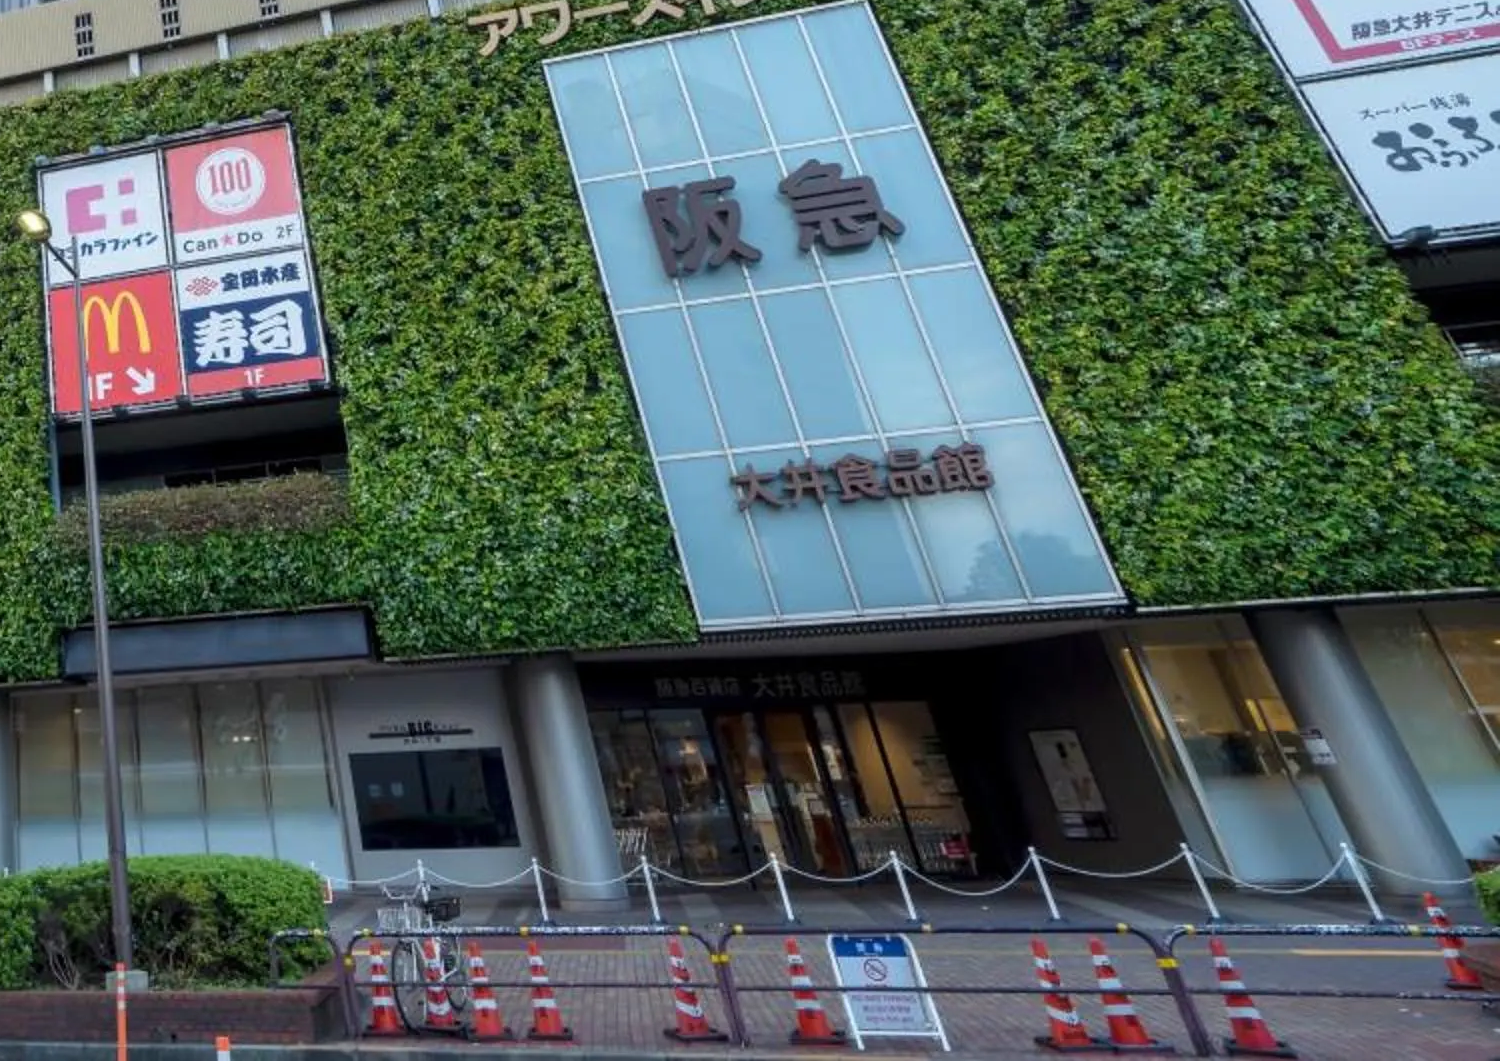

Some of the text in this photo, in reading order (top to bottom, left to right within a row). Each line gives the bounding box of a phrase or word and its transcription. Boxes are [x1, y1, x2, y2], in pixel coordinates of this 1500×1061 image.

[1371, 109, 1500, 172] おふろ
[207, 156, 252, 196] 100
[276, 223, 295, 240] 2F
[642, 158, 906, 278] 阪急
[193, 299, 308, 367] 寿司
[243, 368, 265, 387] 1F
[731, 440, 994, 512] 大井食品館
